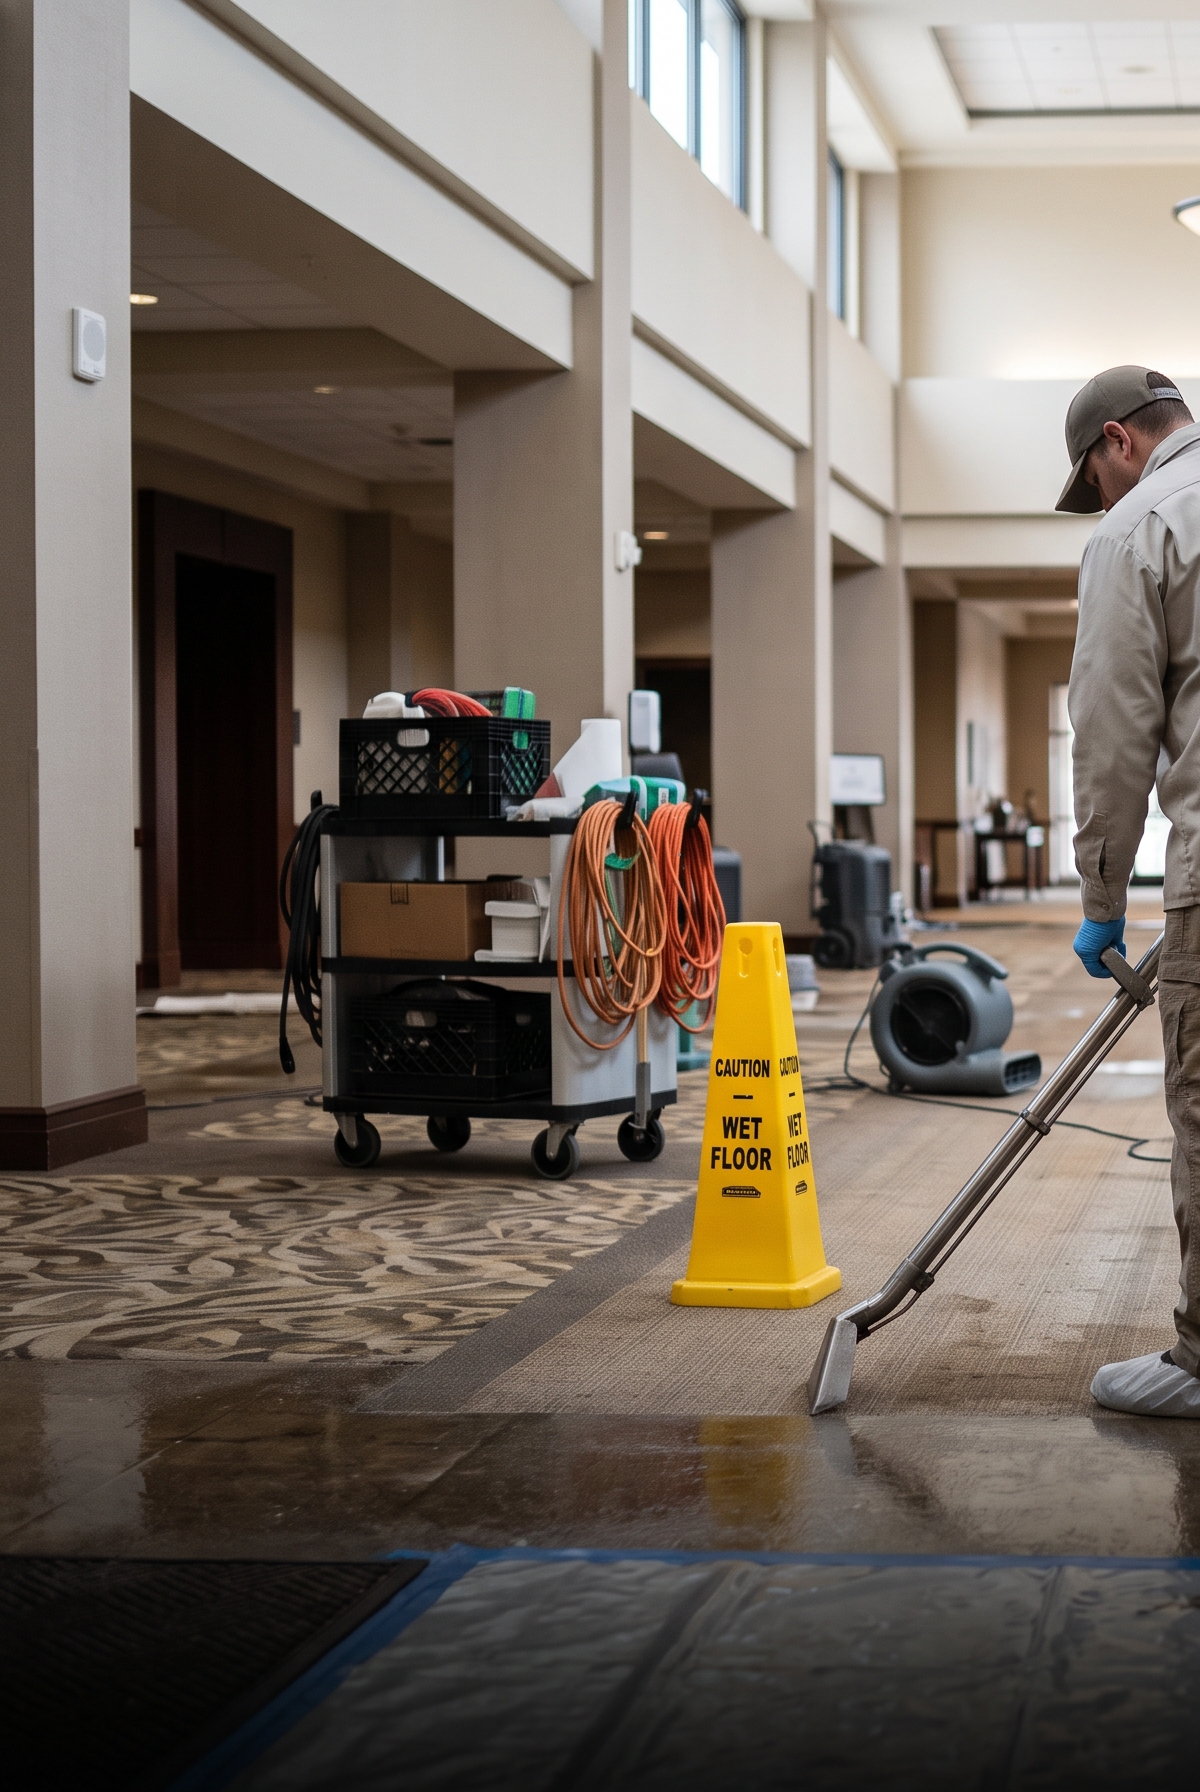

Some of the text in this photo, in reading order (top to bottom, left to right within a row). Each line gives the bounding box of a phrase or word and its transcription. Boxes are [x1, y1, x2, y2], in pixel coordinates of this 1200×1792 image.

[715, 1058, 770, 1077] CAUTION
[780, 1055, 799, 1076] CAUTION
[722, 1116, 762, 1139] WET
[787, 1112, 802, 1138] WET
[711, 1147, 772, 1170] FLOOR
[787, 1141, 809, 1169] FLOOR
